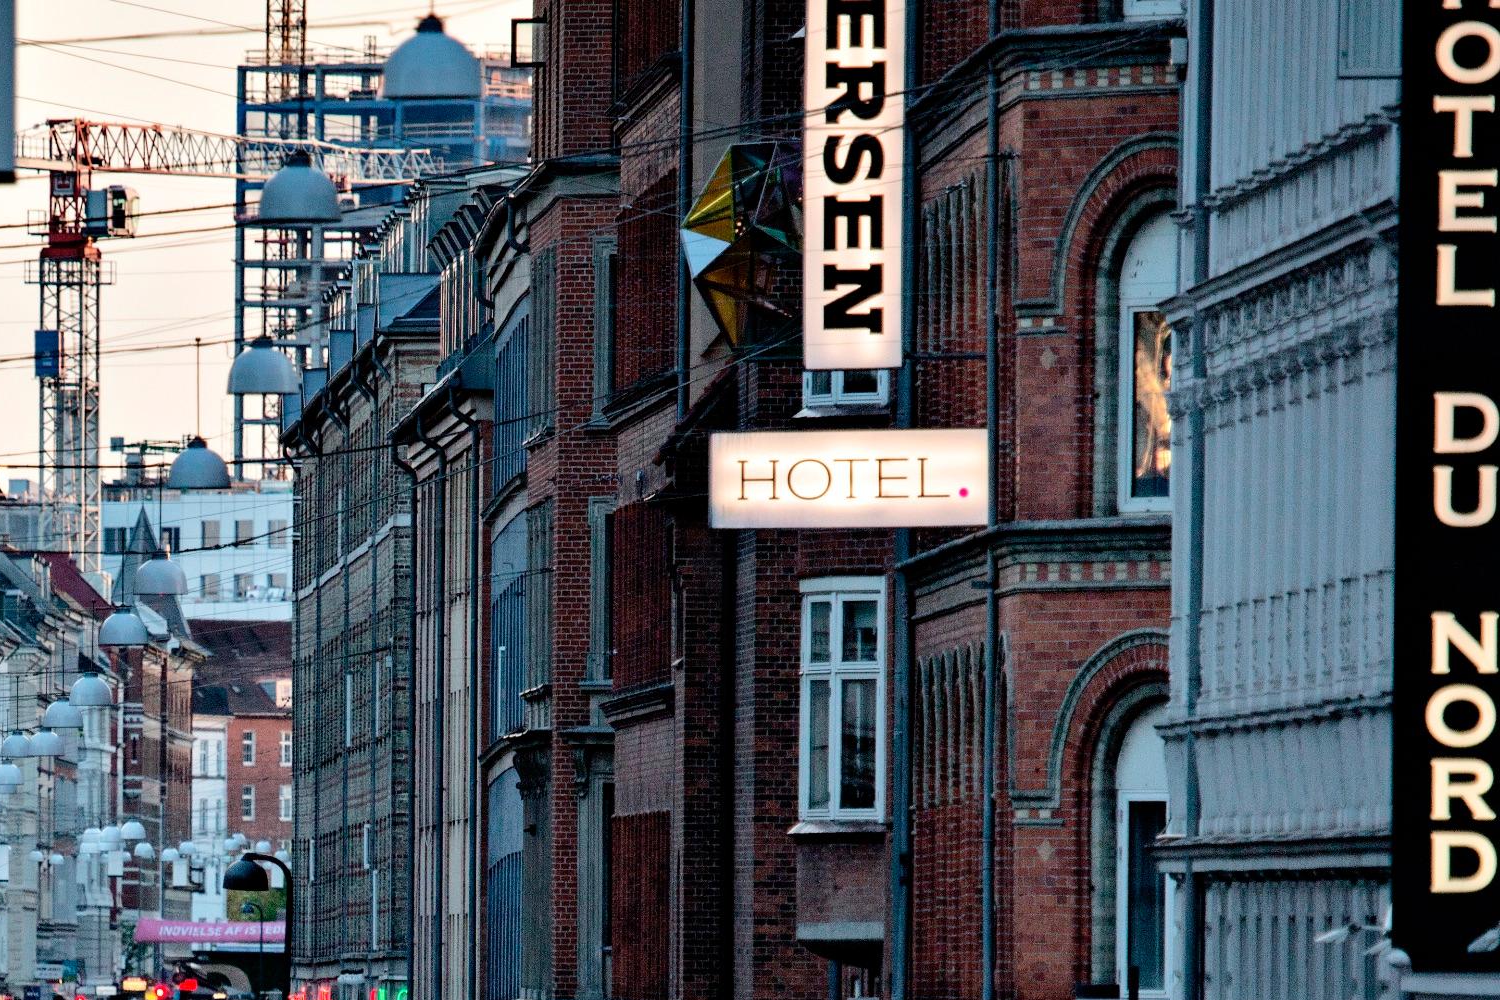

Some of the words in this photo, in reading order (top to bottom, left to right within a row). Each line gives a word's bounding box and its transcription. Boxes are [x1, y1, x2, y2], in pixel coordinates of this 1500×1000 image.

[823, 0, 886, 334] ERSEN
[1433, 0, 1500, 306] OTEL
[1434, 392, 1499, 528] DU
[1425, 612, 1500, 894] NORD
